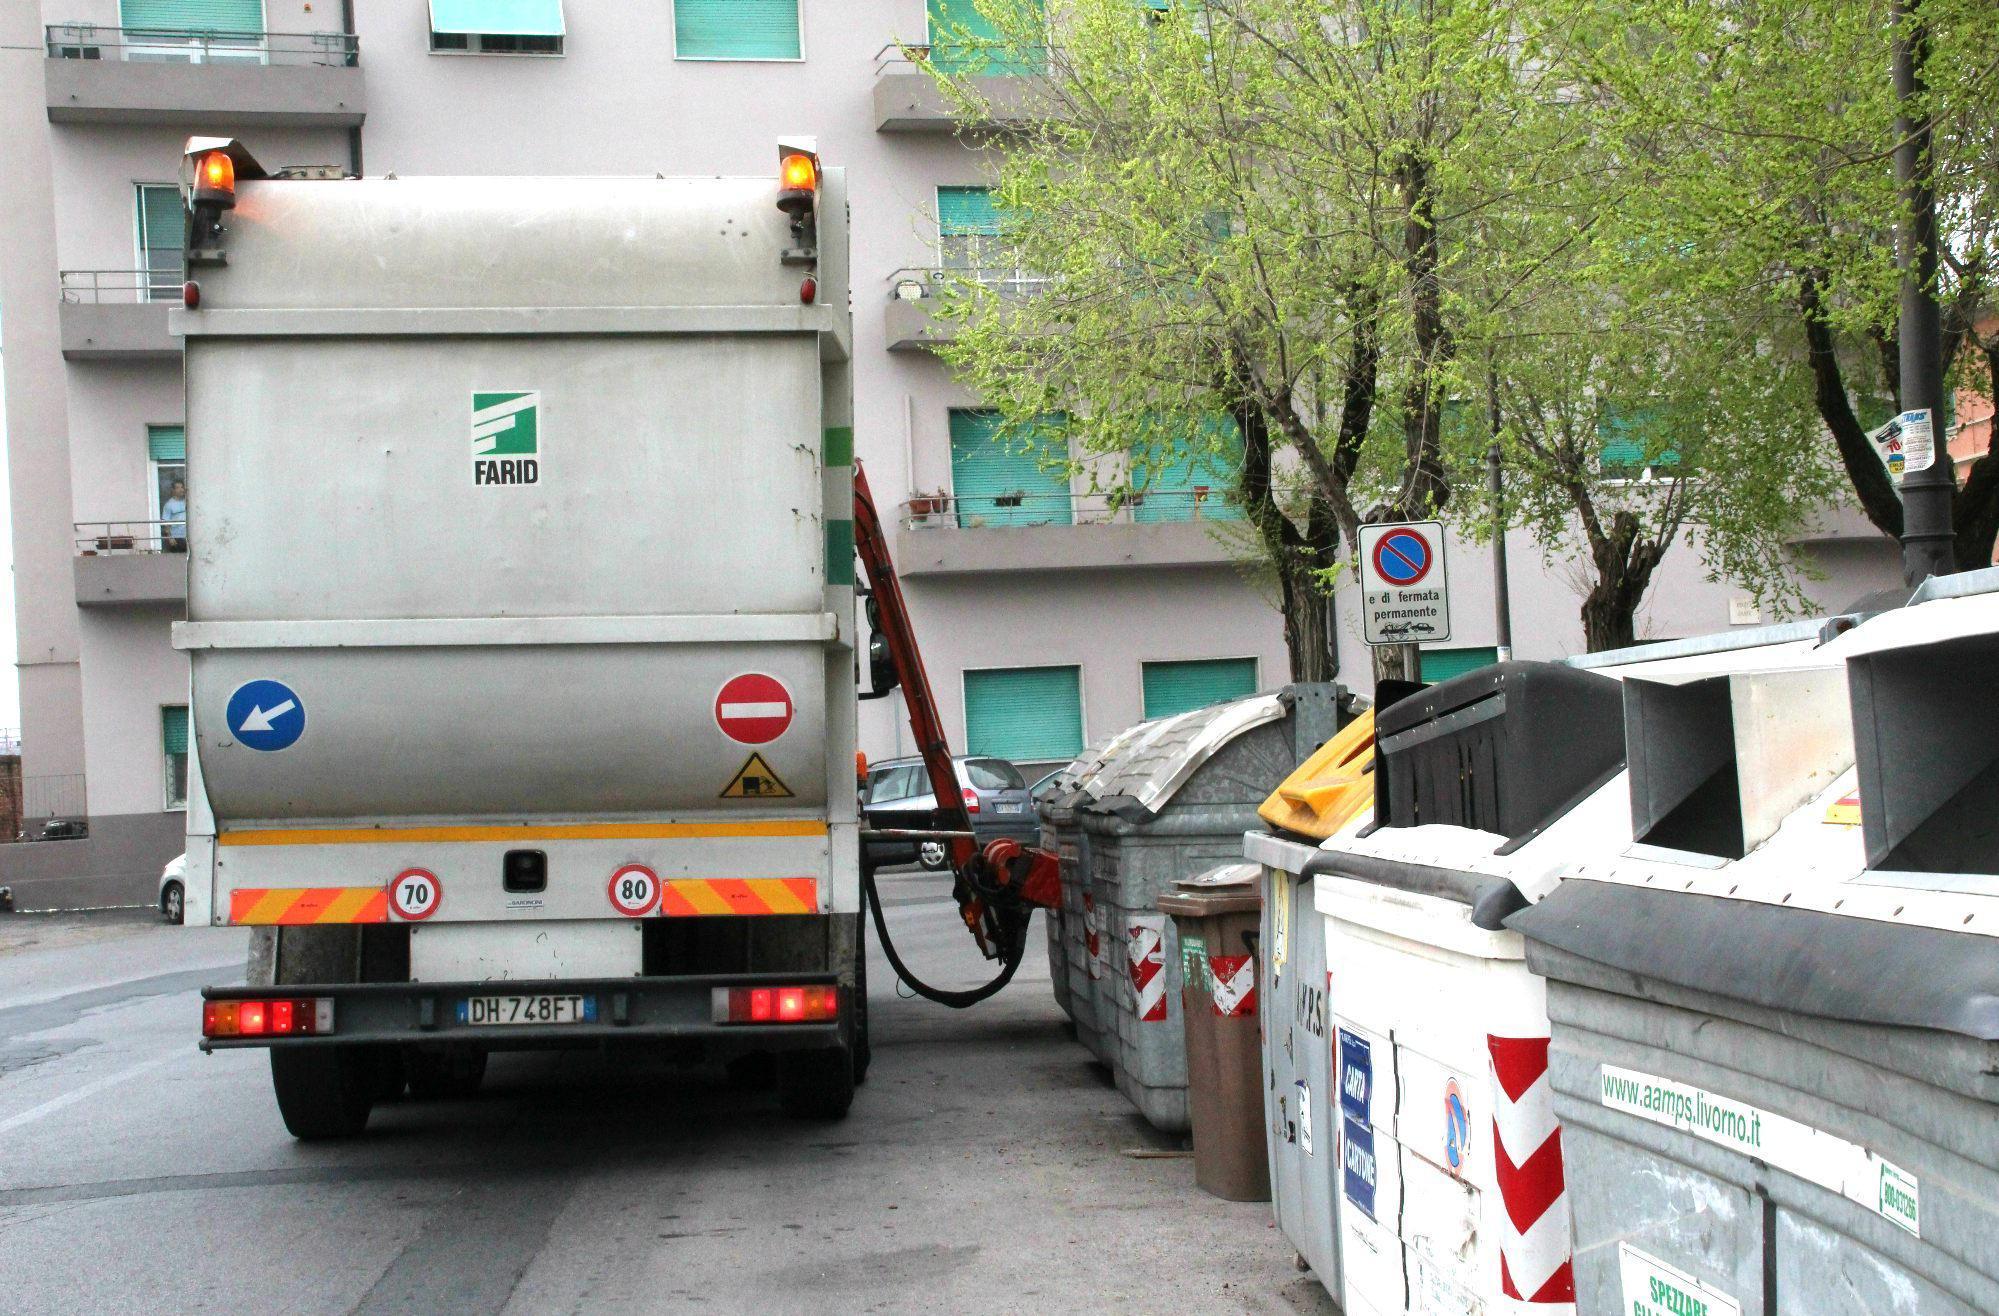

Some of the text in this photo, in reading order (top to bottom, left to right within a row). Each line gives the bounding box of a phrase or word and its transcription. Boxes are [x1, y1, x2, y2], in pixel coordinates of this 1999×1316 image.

[475, 460, 538, 485] FARID
[1369, 590, 1440, 604] e di fermata
[1374, 606, 1437, 623] permanente
[405, 884, 428, 905] 70
[622, 880, 647, 900] 80
[1345, 1063, 1366, 1104] CARTA
[1603, 1074, 1761, 1147] www.aamps.livorno.it
[1346, 1138, 1375, 1187] CARTONE
